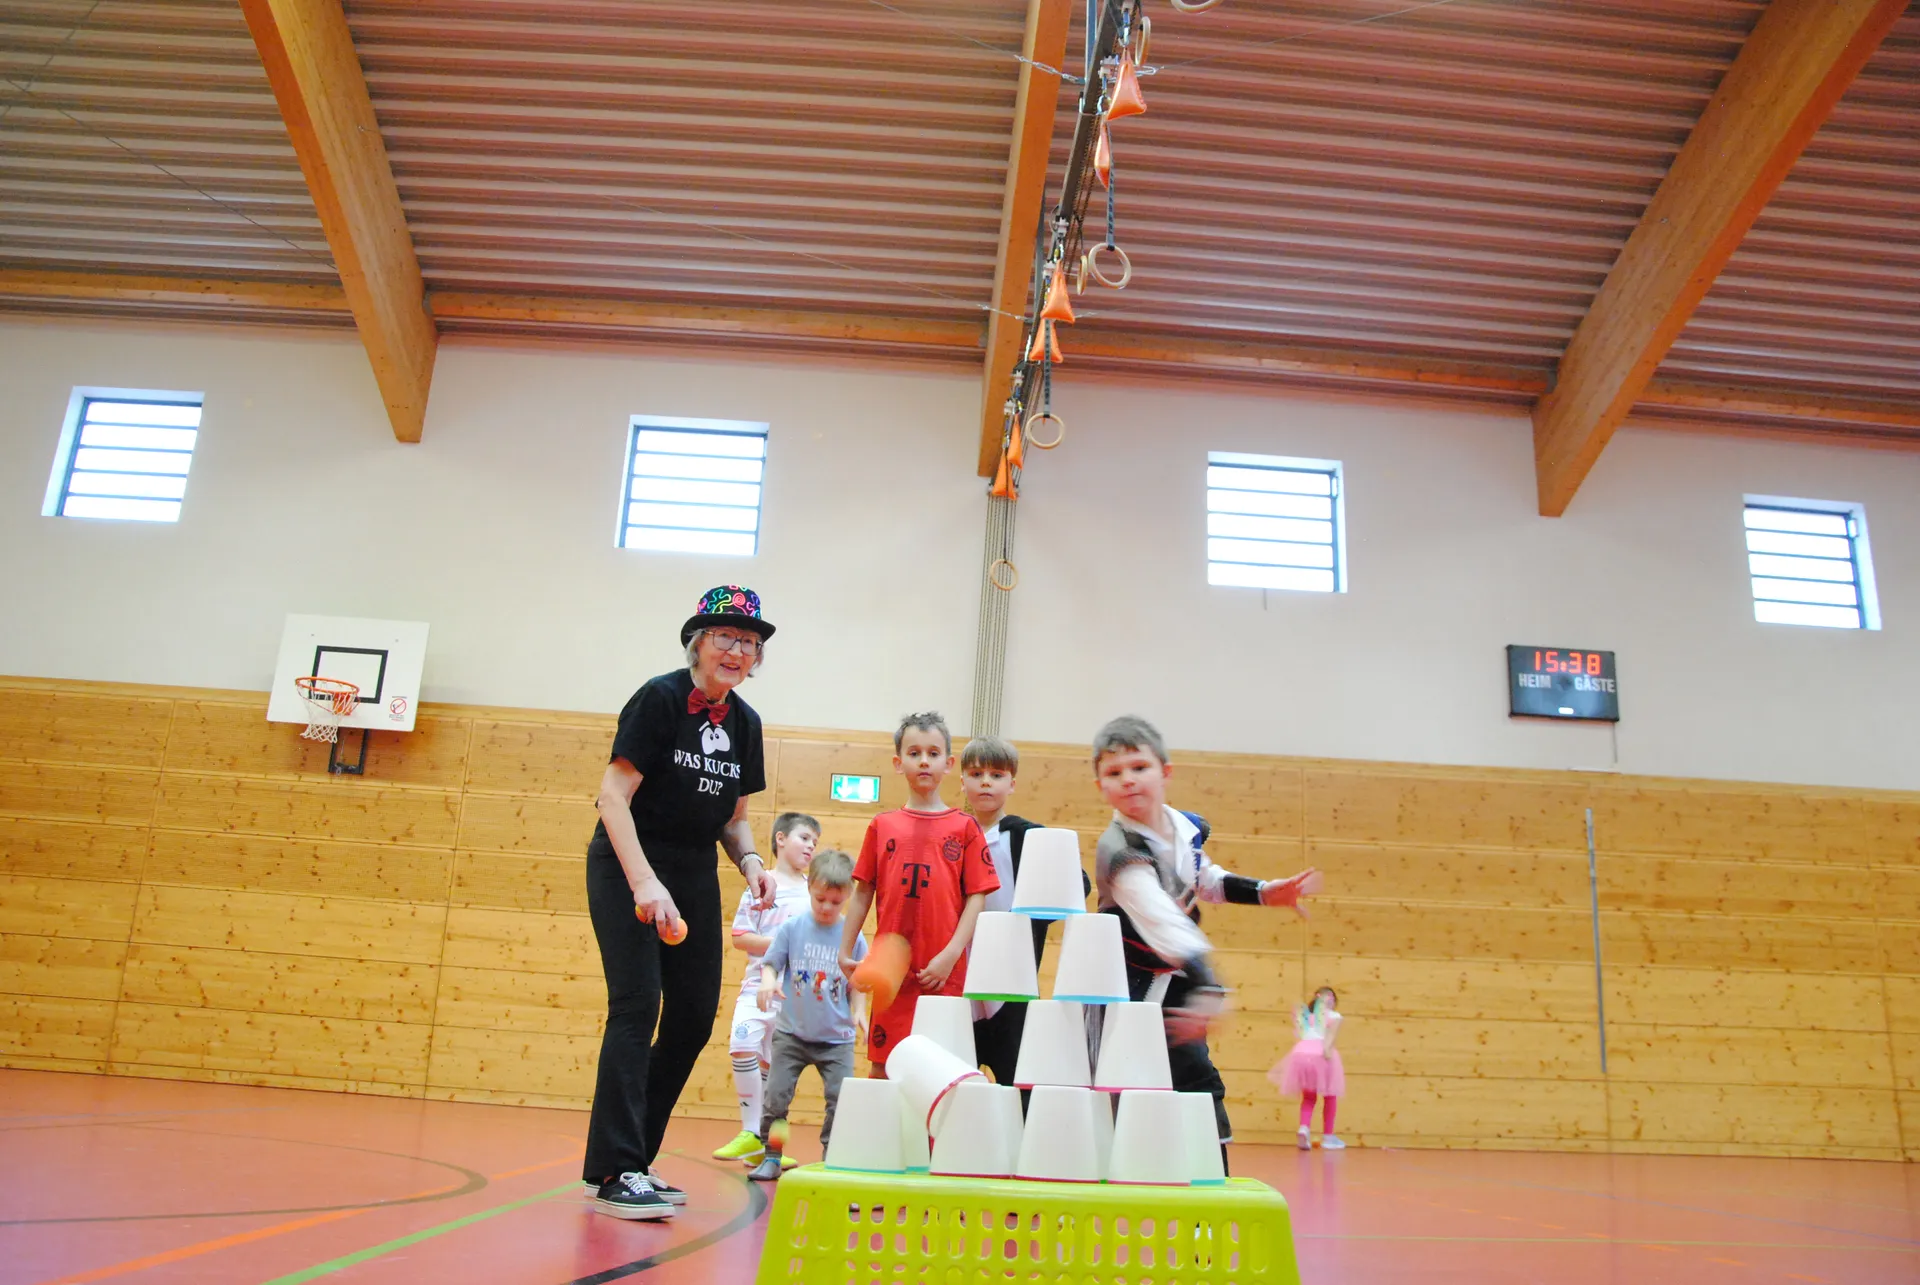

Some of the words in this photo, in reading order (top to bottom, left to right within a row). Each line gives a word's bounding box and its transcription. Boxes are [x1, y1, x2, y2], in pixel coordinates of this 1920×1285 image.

[1519, 673, 1551, 688] HEIM
[1574, 675, 1615, 693] GÄSTE
[674, 749, 701, 770] WAS
[697, 777, 723, 796] DU?
[902, 863, 930, 898] T
